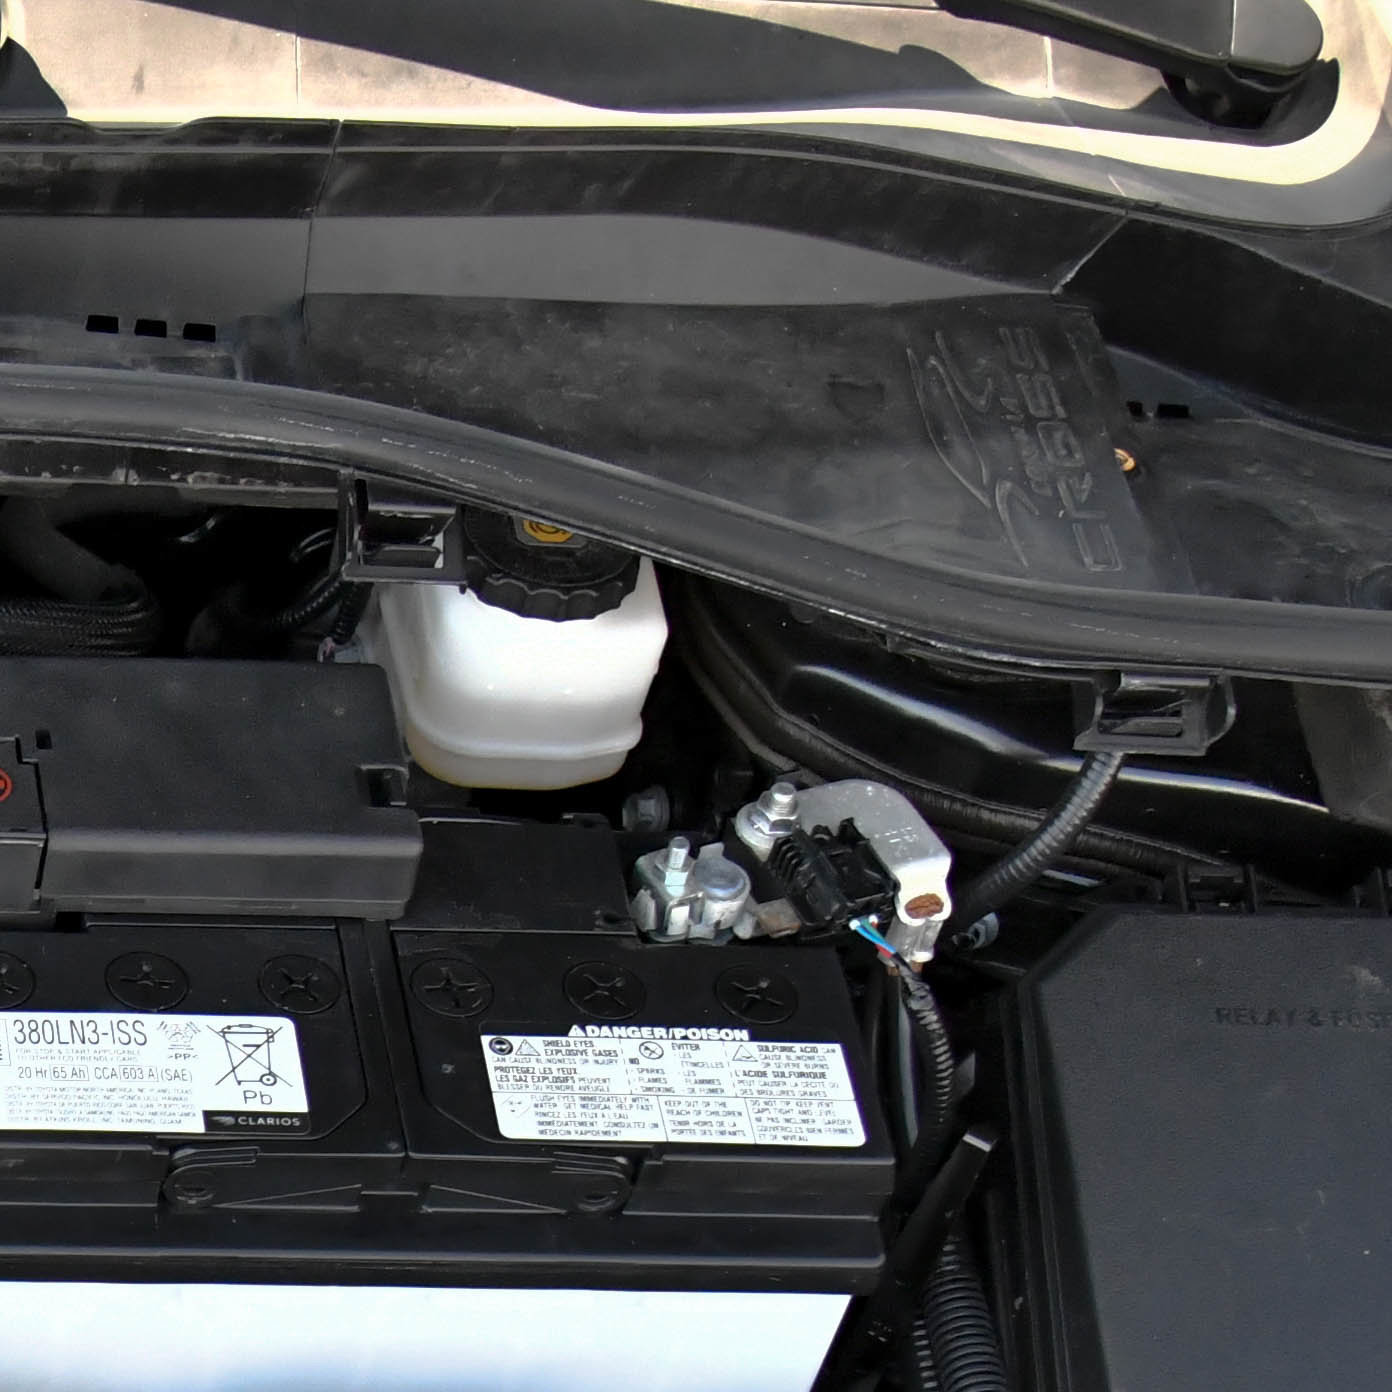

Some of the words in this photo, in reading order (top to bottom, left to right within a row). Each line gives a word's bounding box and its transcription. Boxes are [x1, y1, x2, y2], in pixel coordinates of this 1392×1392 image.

[12, 1019, 148, 1047] 380LN3-ISS
[584, 1025, 750, 1042] DANGER/POISON
[543, 1039, 571, 1048] SHIELD
[544, 1049, 589, 1057] EXPLOSIVE
[592, 1049, 618, 1058] GASES
[757, 1044, 796, 1053] SULFURIC
[799, 1045, 818, 1054] ACID
[18, 1066, 32, 1079] 20
[35, 1066, 48, 1079] Hr
[52, 1066, 67, 1079] 65
[71, 1066, 86, 1080] Ah
[94, 1066, 118, 1080] CCA
[122, 1067, 145, 1080] 603
[148, 1067, 156, 1079] A
[160, 1067, 193, 1082] (SAE)
[539, 1066, 553, 1074] LES
[772, 1070, 827, 1079] SULFURIQUE
[512, 1075, 528, 1083] GAZ
[242, 1089, 273, 1105] Pb
[237, 1116, 301, 1127] CLARIOS
